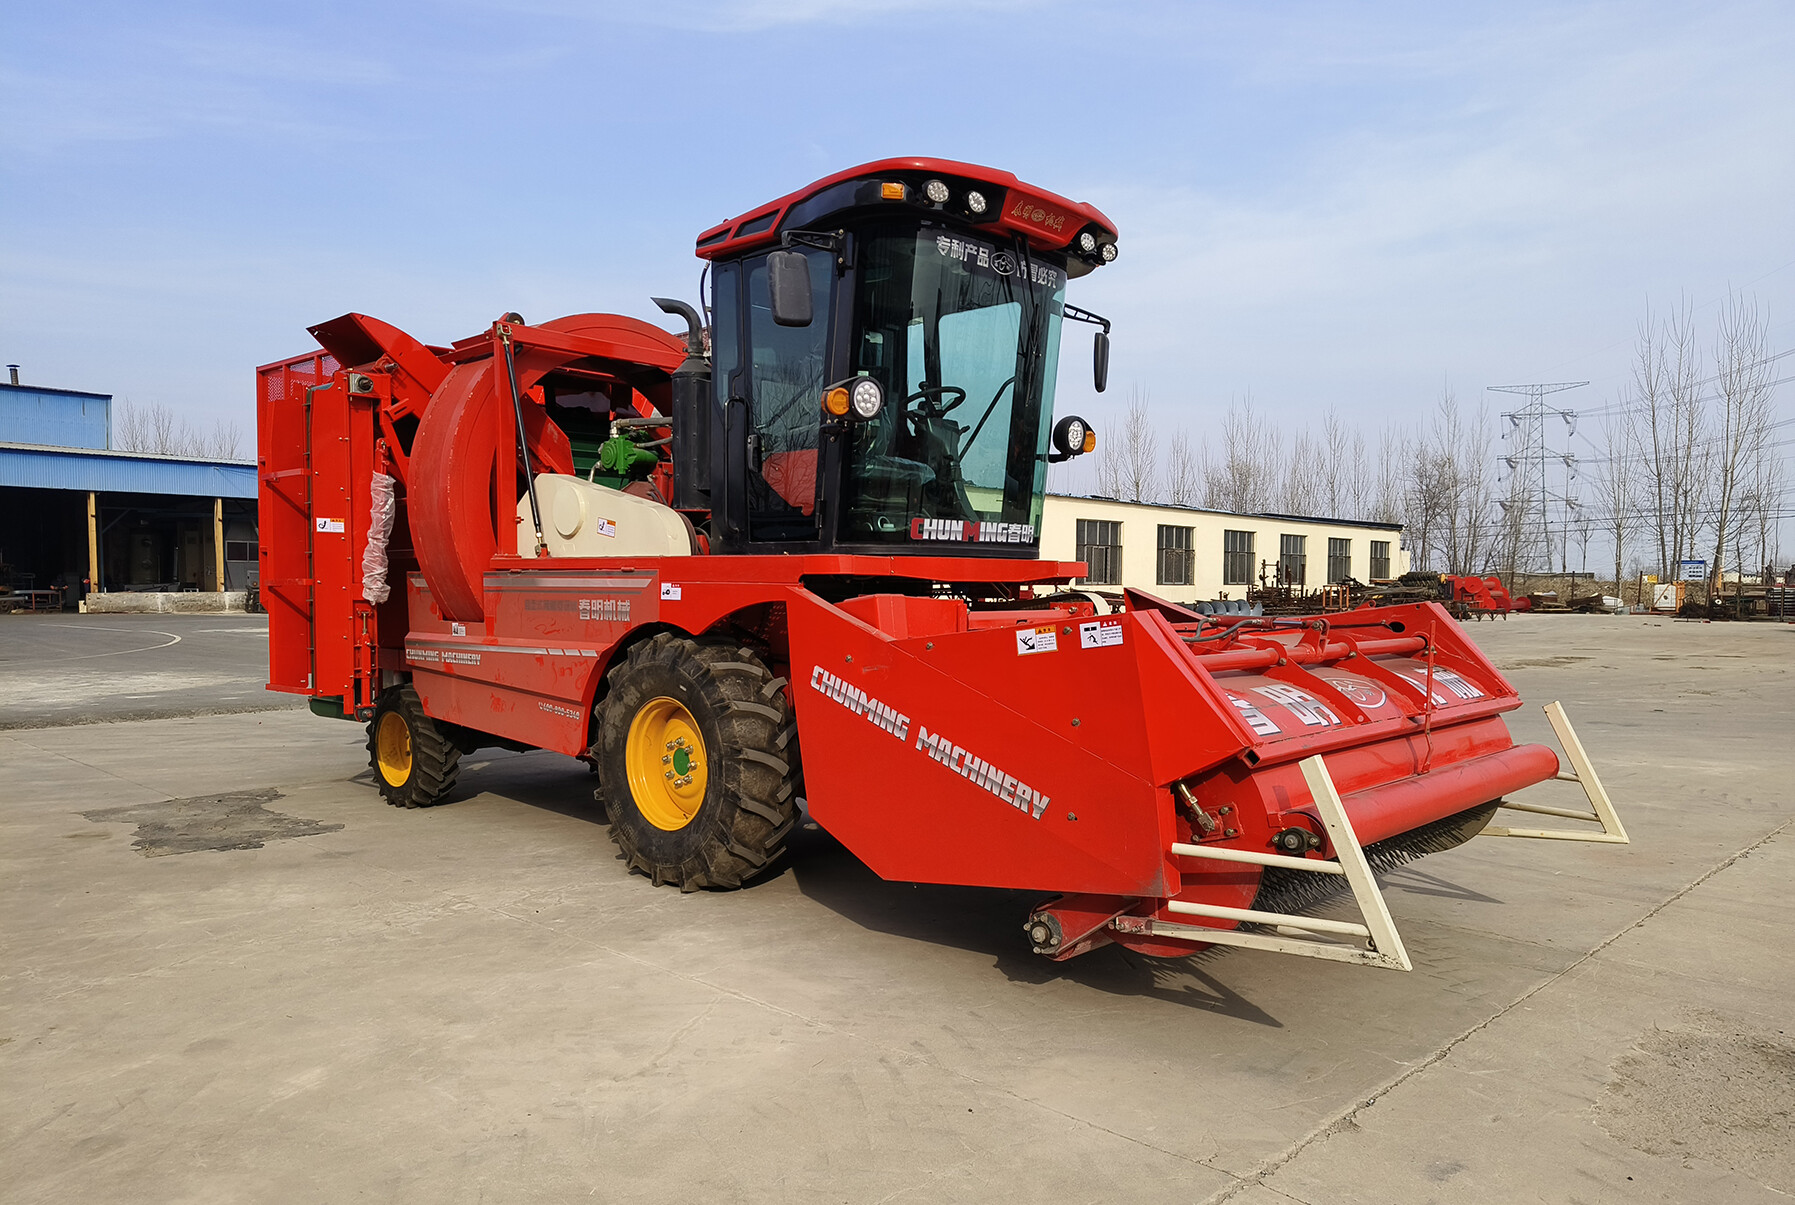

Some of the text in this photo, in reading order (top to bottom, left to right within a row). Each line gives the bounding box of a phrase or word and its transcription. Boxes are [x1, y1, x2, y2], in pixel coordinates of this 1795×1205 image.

[936, 235, 990, 268] 专利产品
[910, 517, 1035, 543] CHUNMING 春明
[578, 599, 631, 621] 春明机械
[810, 665, 1051, 821] CHUNMING MACHINERY
